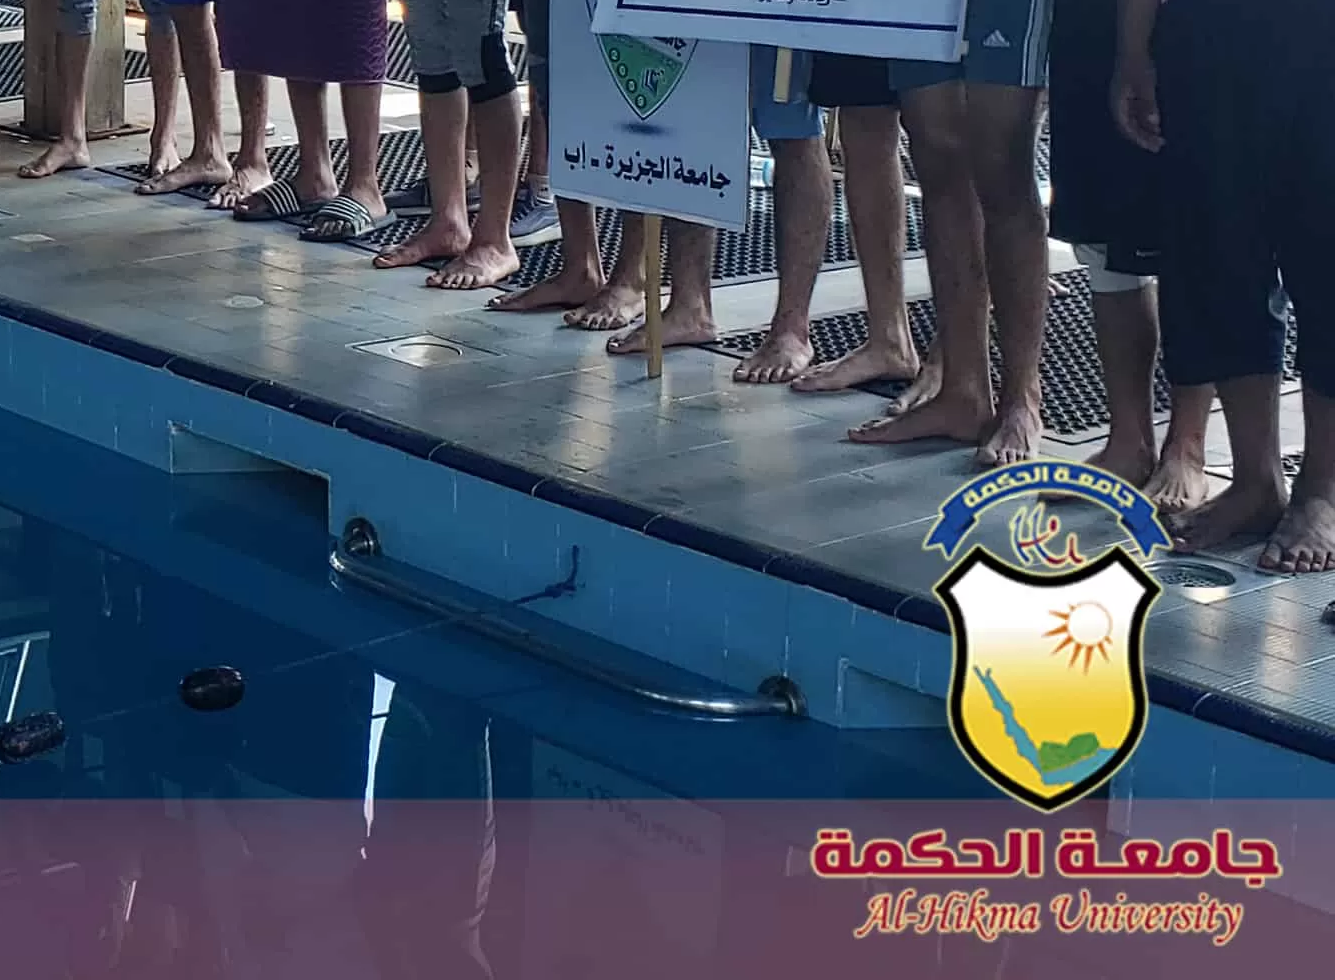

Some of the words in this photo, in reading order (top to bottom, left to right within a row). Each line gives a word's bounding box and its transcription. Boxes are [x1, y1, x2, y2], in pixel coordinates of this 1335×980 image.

[564, 141, 586, 170] إب
[604, 144, 670, 185] الجزيرة
[673, 157, 732, 198] جامعة
